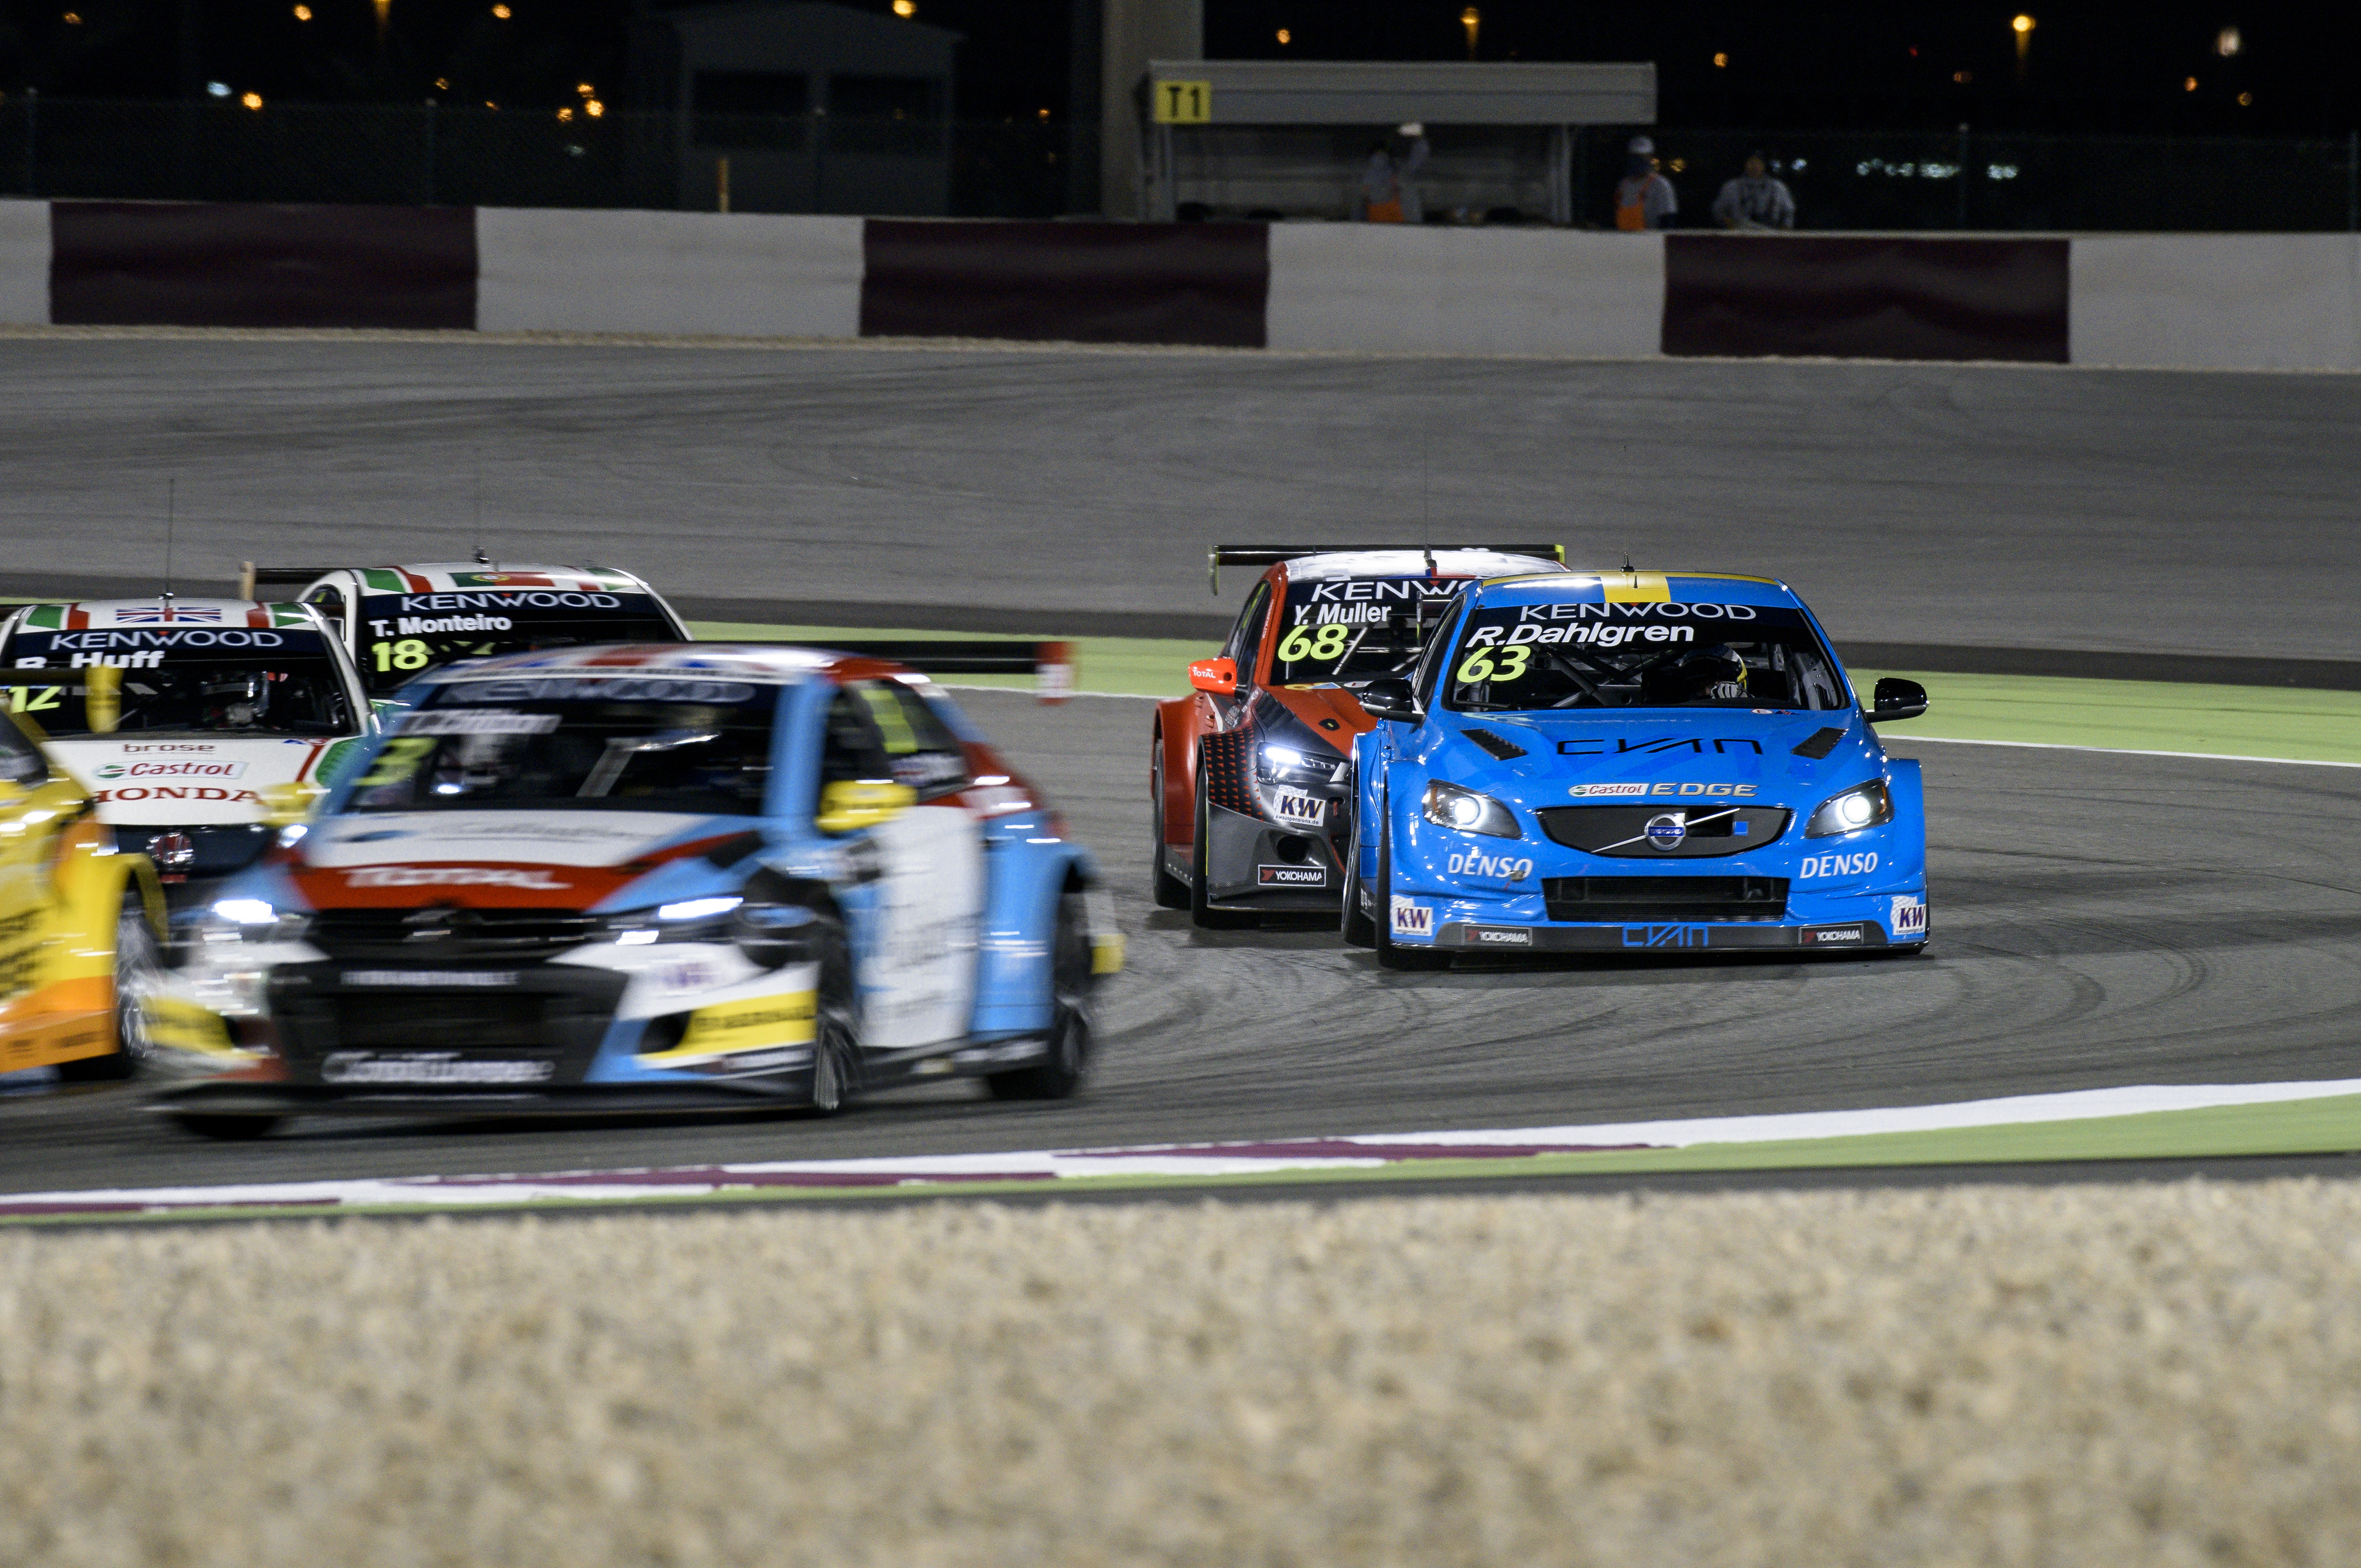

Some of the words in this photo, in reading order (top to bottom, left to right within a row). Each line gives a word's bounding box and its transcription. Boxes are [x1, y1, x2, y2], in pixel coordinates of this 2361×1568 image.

[1168, 86, 1200, 117] T1
[401, 592, 622, 612] KENWOOD
[1520, 602, 1757, 622] KENWOOD
[368, 619, 394, 637] T.
[398, 613, 512, 635] Monteiro
[1294, 605, 1310, 626] Y.
[1317, 603, 1391, 624] Muller
[49, 630, 284, 651] KENWOOD
[1278, 624, 1348, 662] 68
[1466, 622, 1694, 647] R.Dahlgren
[15, 656, 58, 669] R
[70, 650, 166, 668] Huff
[371, 639, 428, 672] 18
[1456, 645, 1531, 683] 63
[1192, 669, 1216, 678] TOTAL
[123, 743, 215, 752] brose
[130, 762, 235, 776] Castrol
[1588, 784, 1643, 795] Castrol
[1649, 783, 1761, 798] EDGE
[1280, 795, 1324, 820] KW
[1275, 814, 1319, 825] kwsuspensions.de
[1275, 869, 1323, 882] YOKOHAMA
[1448, 853, 1533, 878] DENSO
[1799, 852, 1878, 879] DENSO
[1397, 907, 1430, 929] KW
[1899, 905, 1926, 928] KW
[1816, 929, 1861, 942] YOKOHAMA
